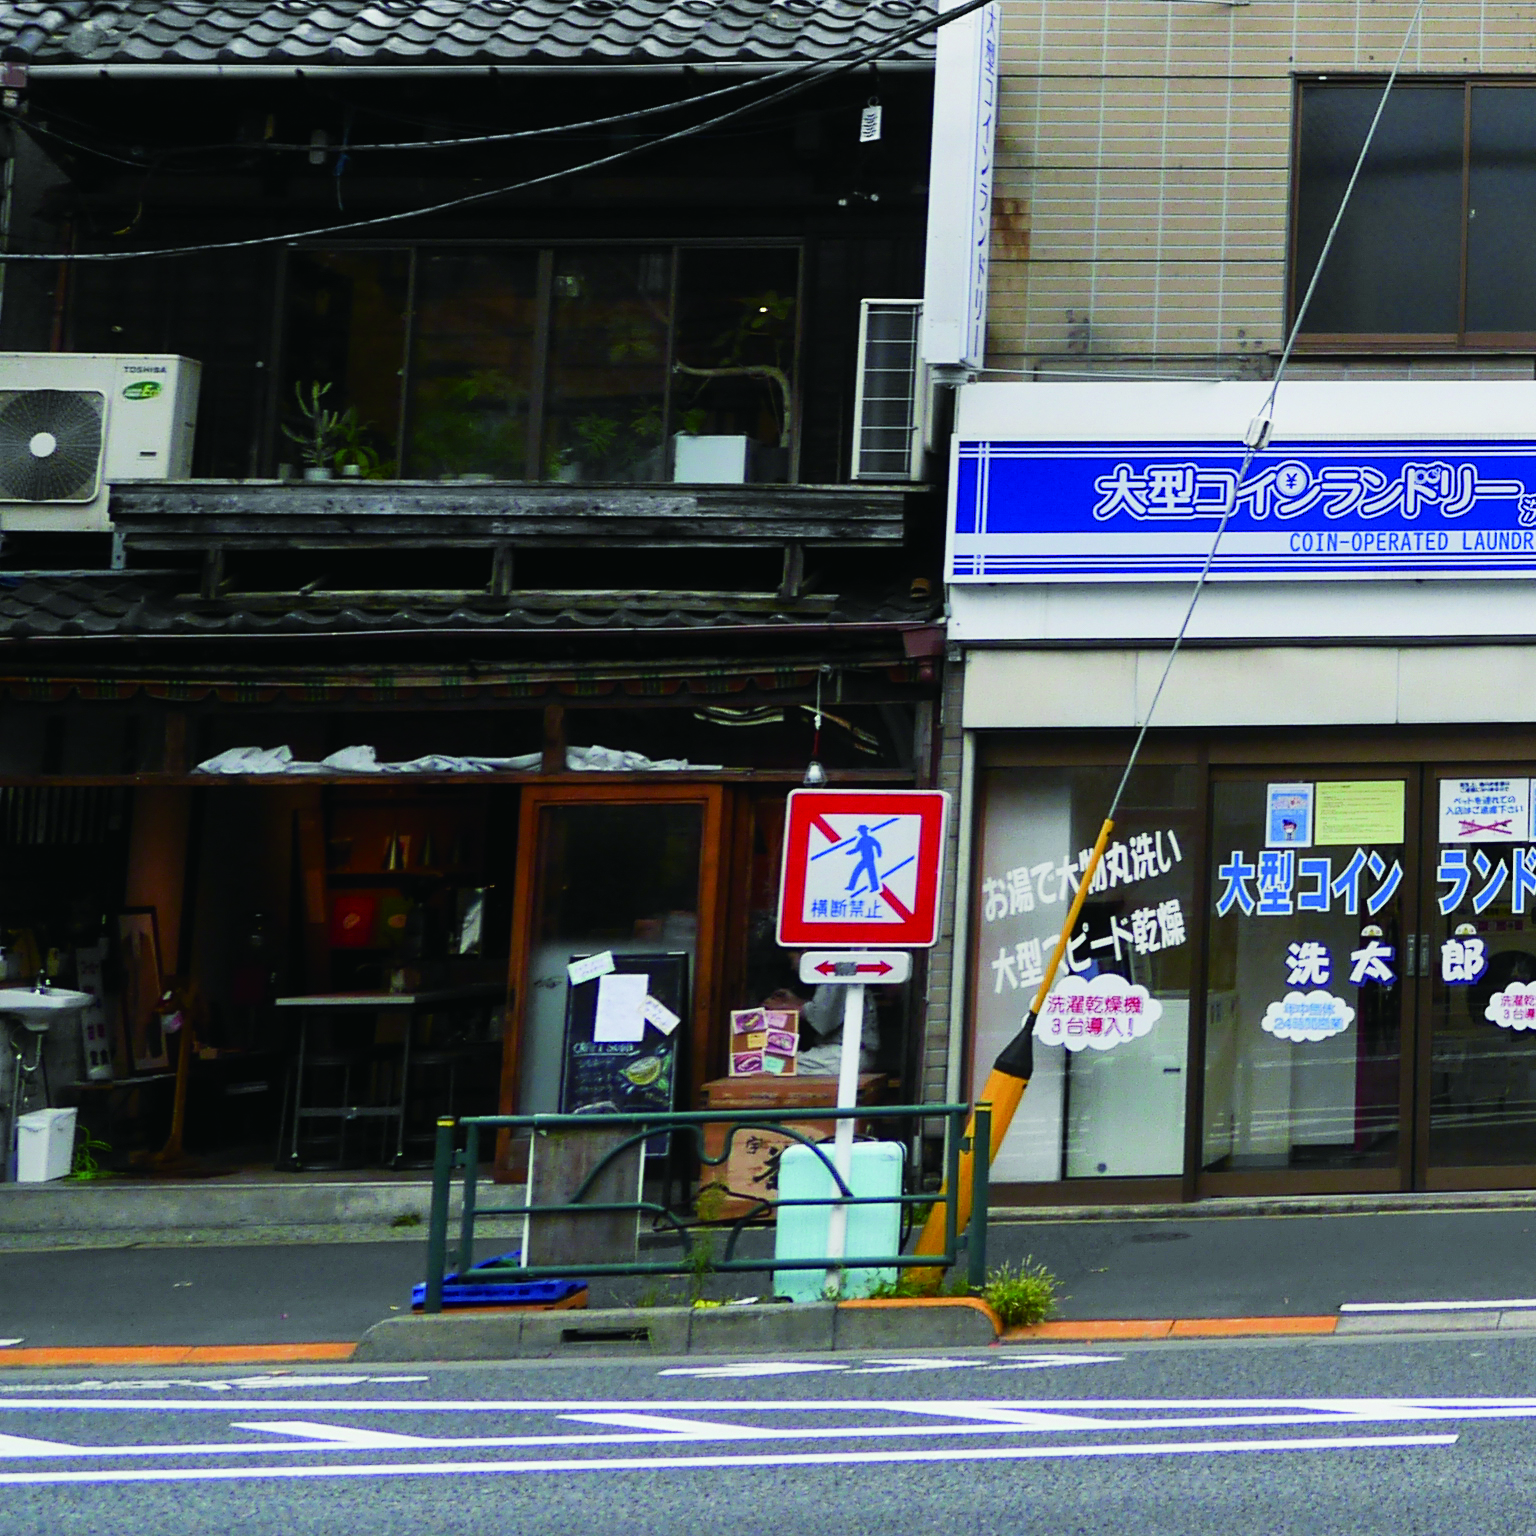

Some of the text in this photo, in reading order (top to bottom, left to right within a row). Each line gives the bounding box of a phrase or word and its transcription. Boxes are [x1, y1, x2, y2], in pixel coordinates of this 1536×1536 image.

[1093, 460, 1525, 521] 大型コインランドリー
[1290, 531, 1449, 553] COIN-OPERATED
[811, 898, 884, 919] 横断禁止
[1047, 994, 1144, 1015] 洗濯乾燥機
